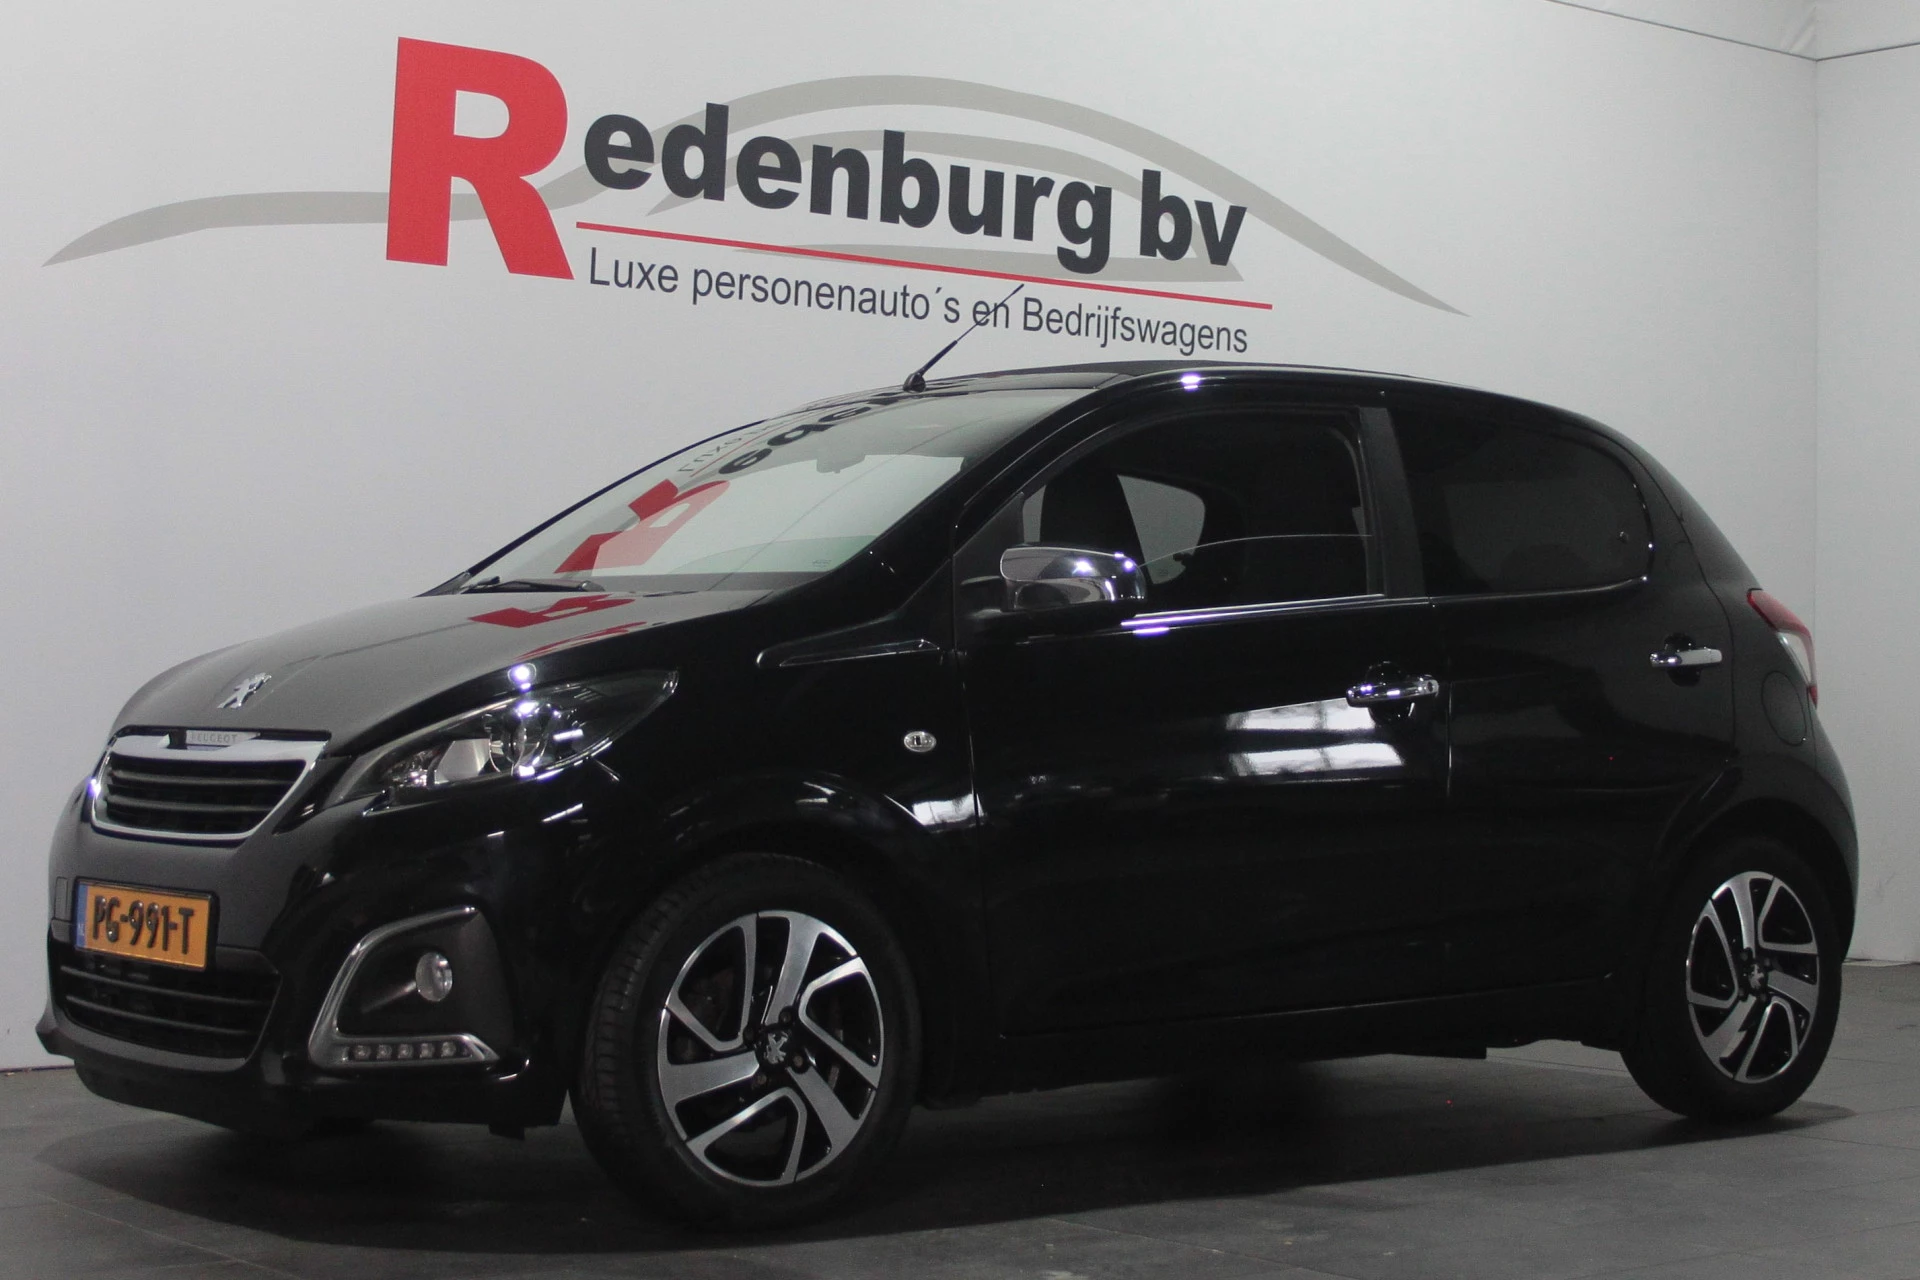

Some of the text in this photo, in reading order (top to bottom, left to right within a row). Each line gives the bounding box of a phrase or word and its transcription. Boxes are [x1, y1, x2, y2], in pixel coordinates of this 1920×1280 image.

[386, 36, 1248, 279] Redenburg bv
[589, 246, 679, 293] Luxe
[972, 298, 1011, 330] en
[1022, 296, 1249, 357] Bedrijfswagens
[92, 894, 195, 956] PG-991-T
